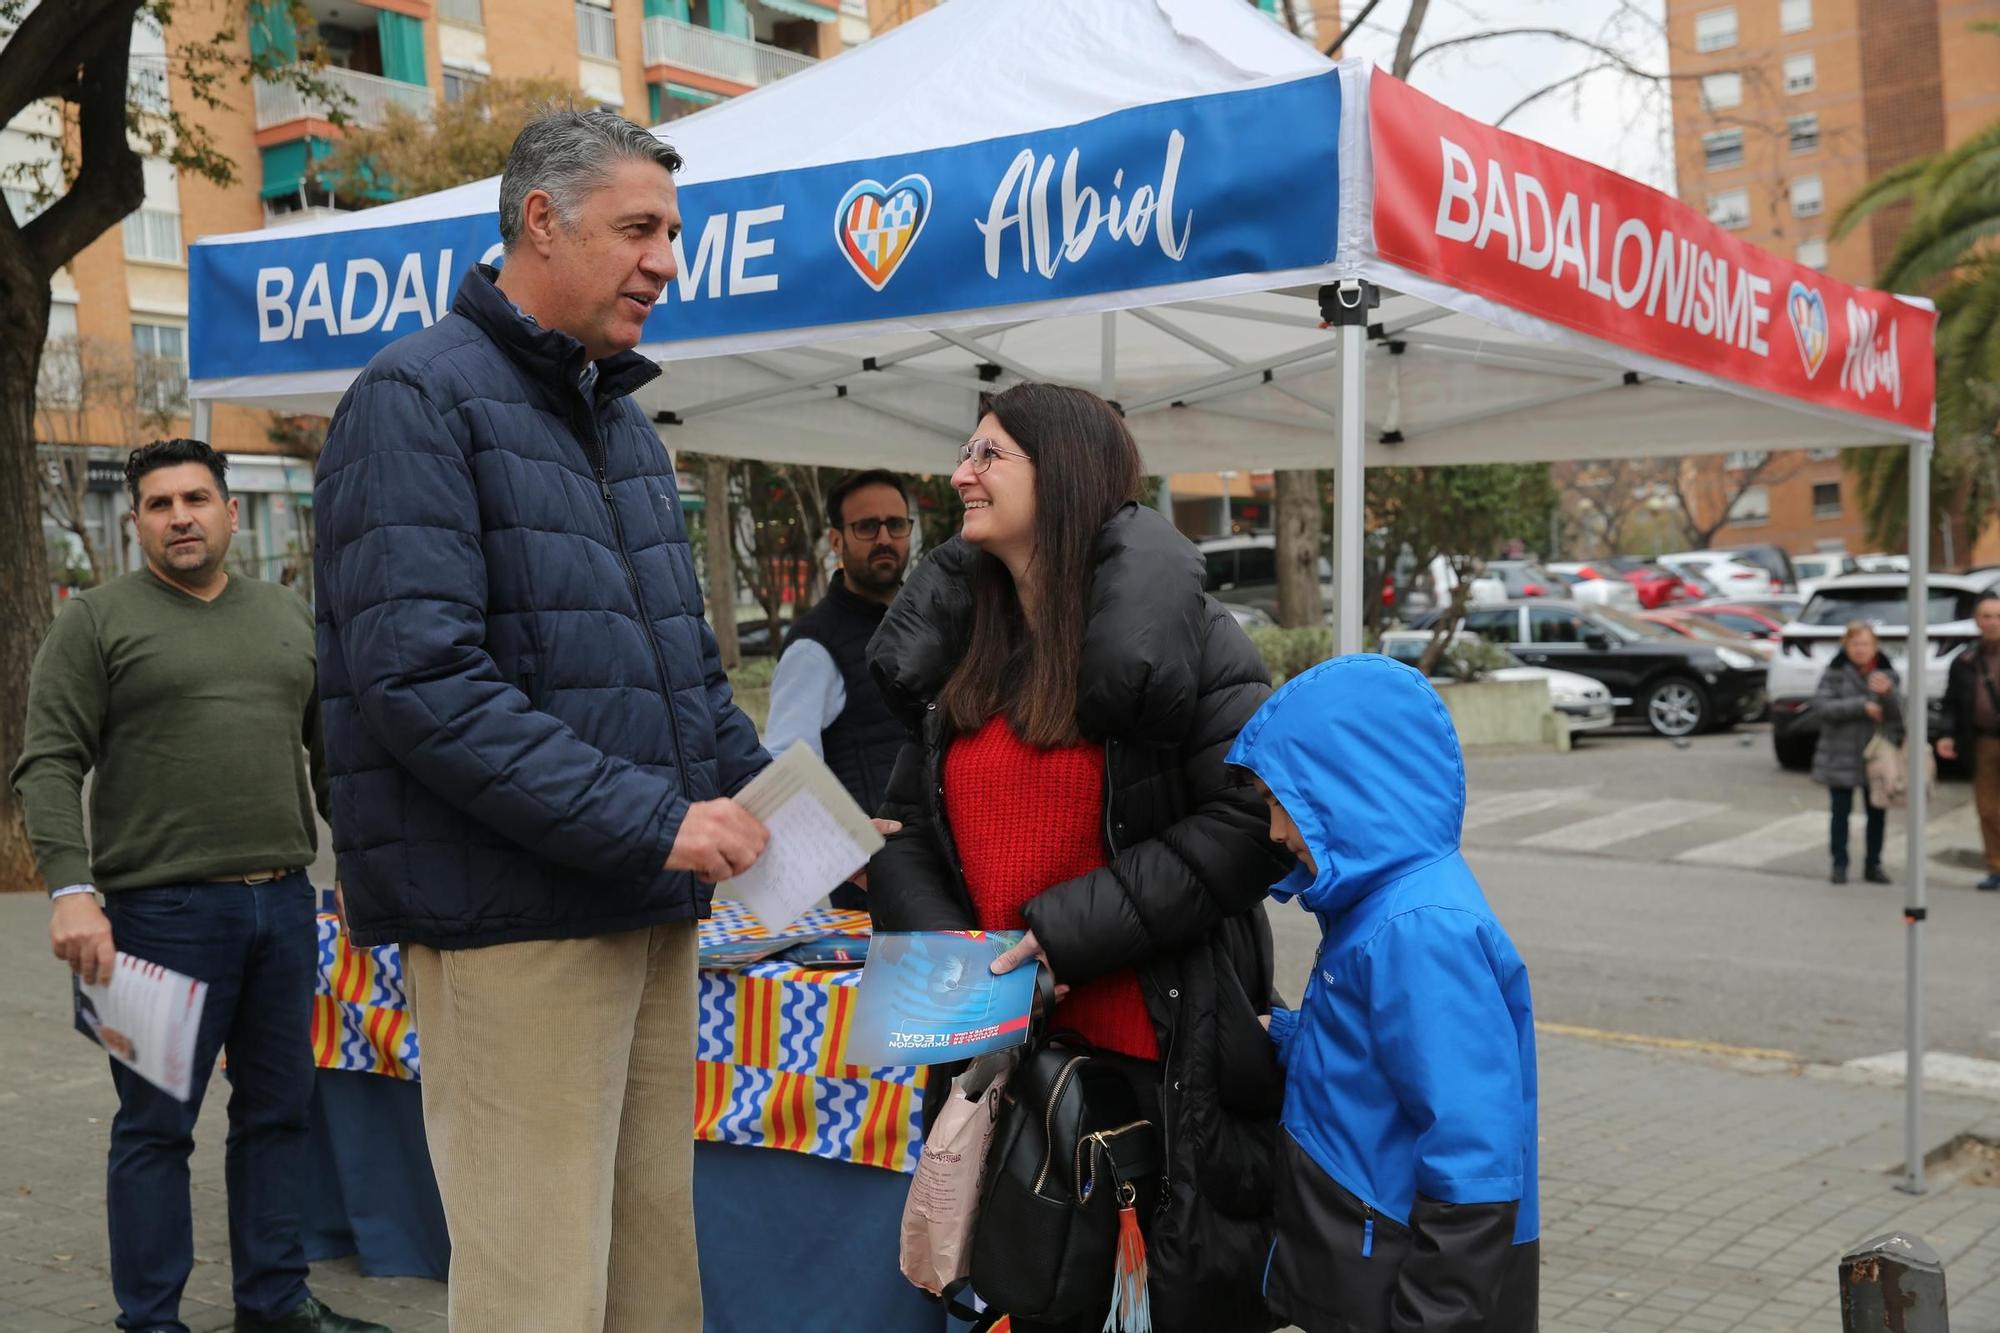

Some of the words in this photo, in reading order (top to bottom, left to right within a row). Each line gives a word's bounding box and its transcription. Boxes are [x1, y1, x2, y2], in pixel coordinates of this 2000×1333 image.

[974, 128, 1194, 280] Albiol
[1435, 136, 1772, 357] BADALONISME
[891, 1032, 951, 1042] ILEGAL
